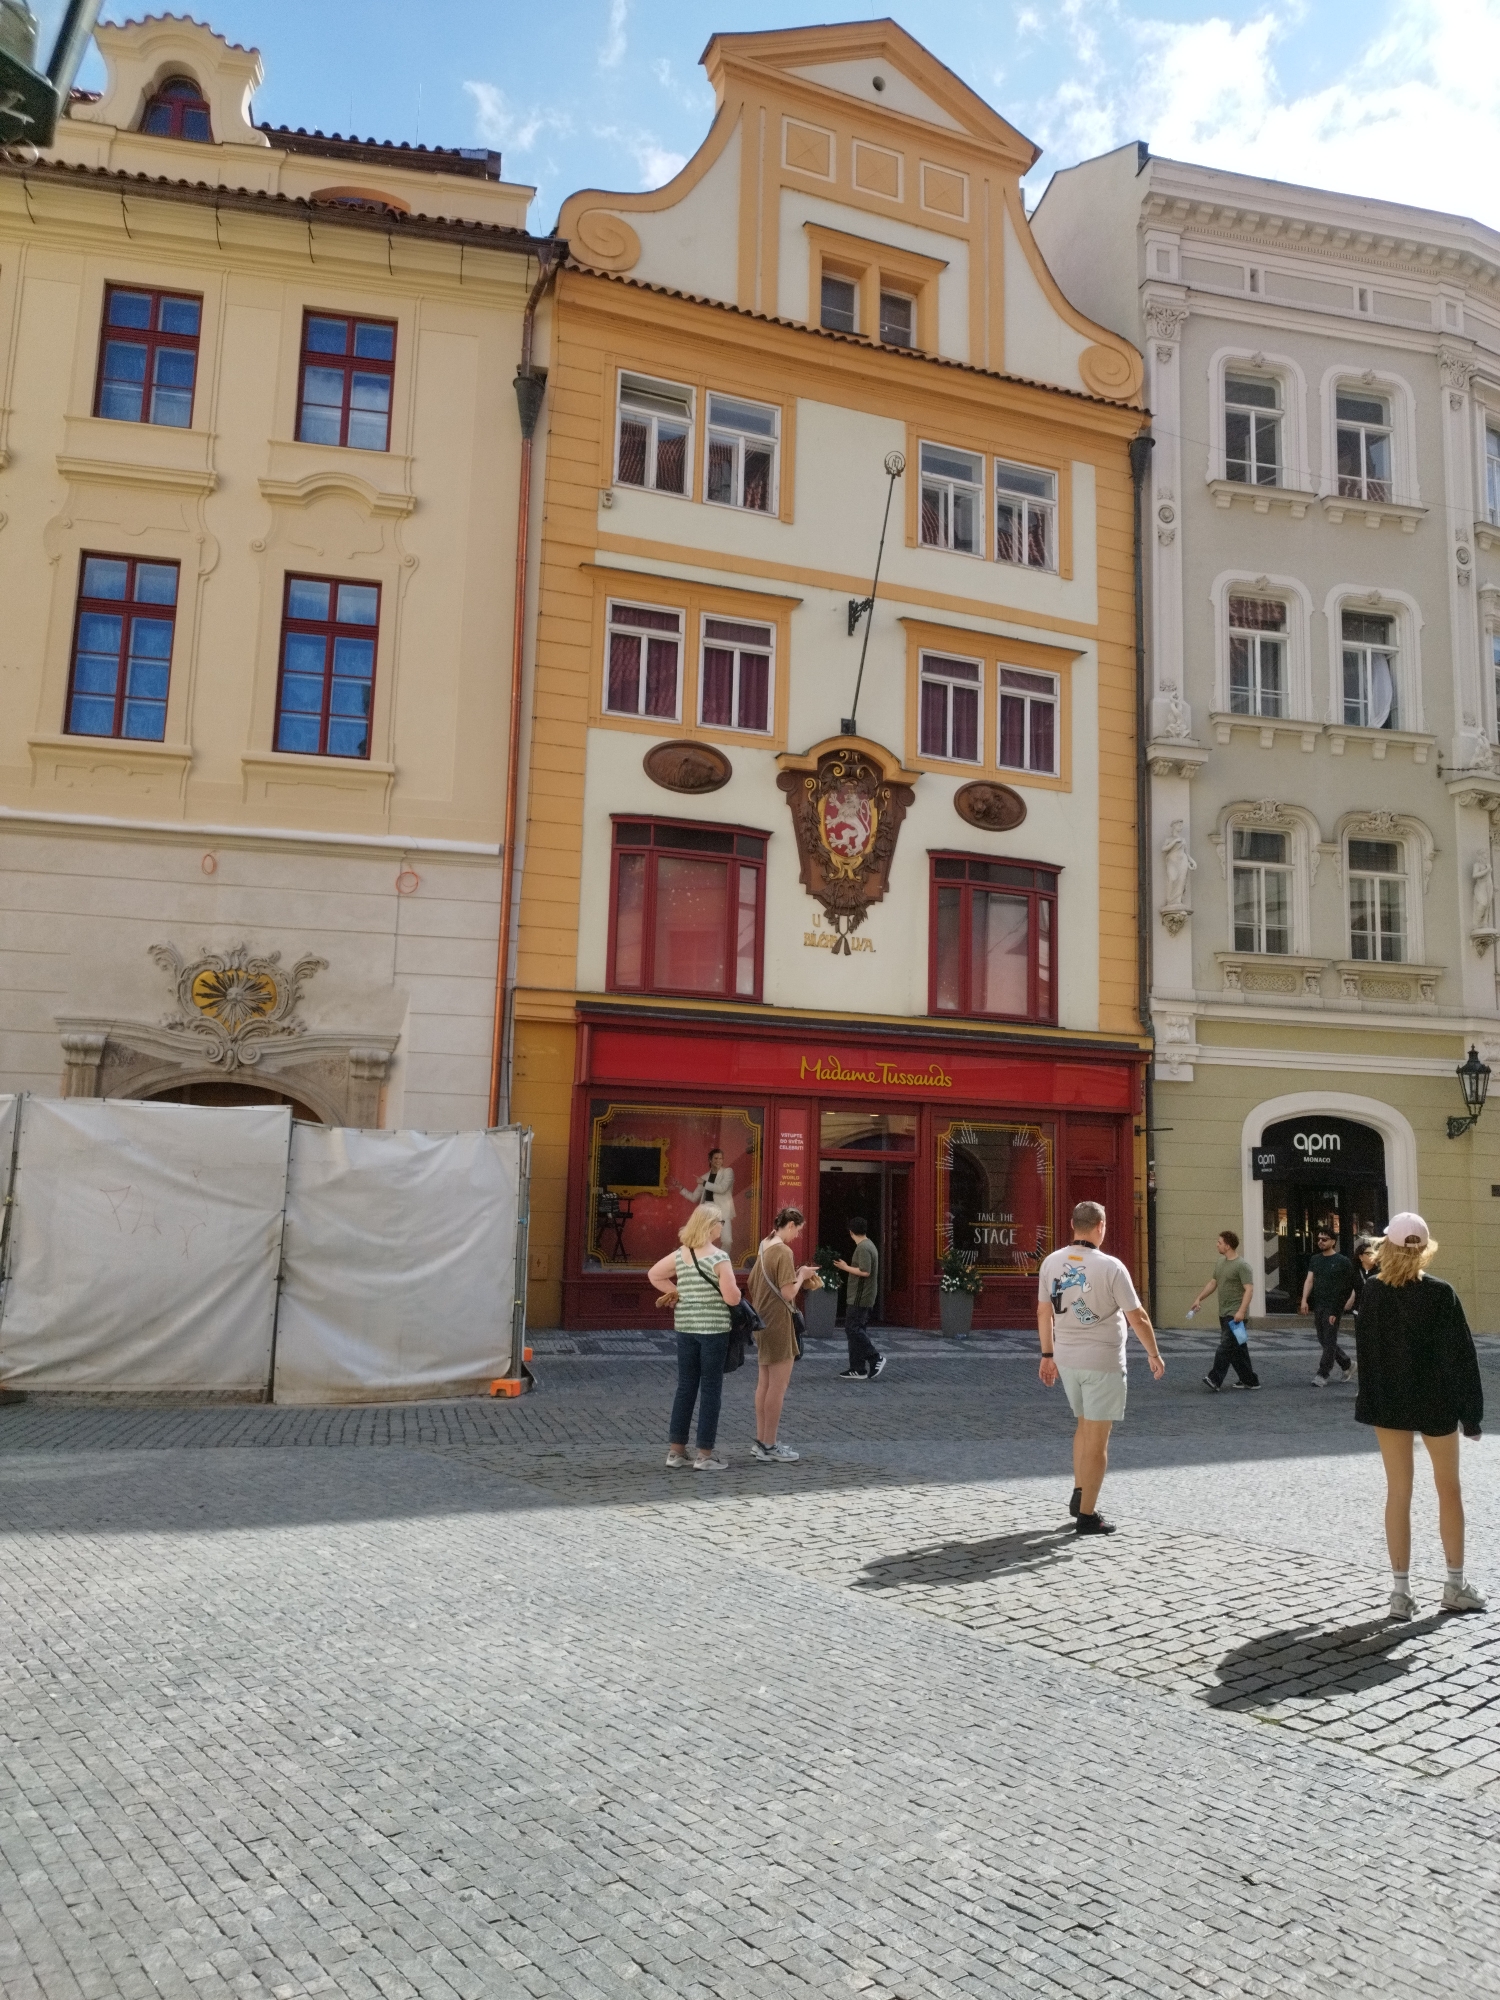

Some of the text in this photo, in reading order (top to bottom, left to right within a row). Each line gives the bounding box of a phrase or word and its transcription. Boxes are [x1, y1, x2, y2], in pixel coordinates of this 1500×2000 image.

[812, 913, 821, 928] U
[800, 1055, 953, 1088] Madame Tussauds
[1293, 1132, 1341, 1156] apm
[1257, 1153, 1276, 1167] apm
[977, 1212, 1014, 1222] TAKE THE
[974, 1228, 1017, 1246] STAGE
